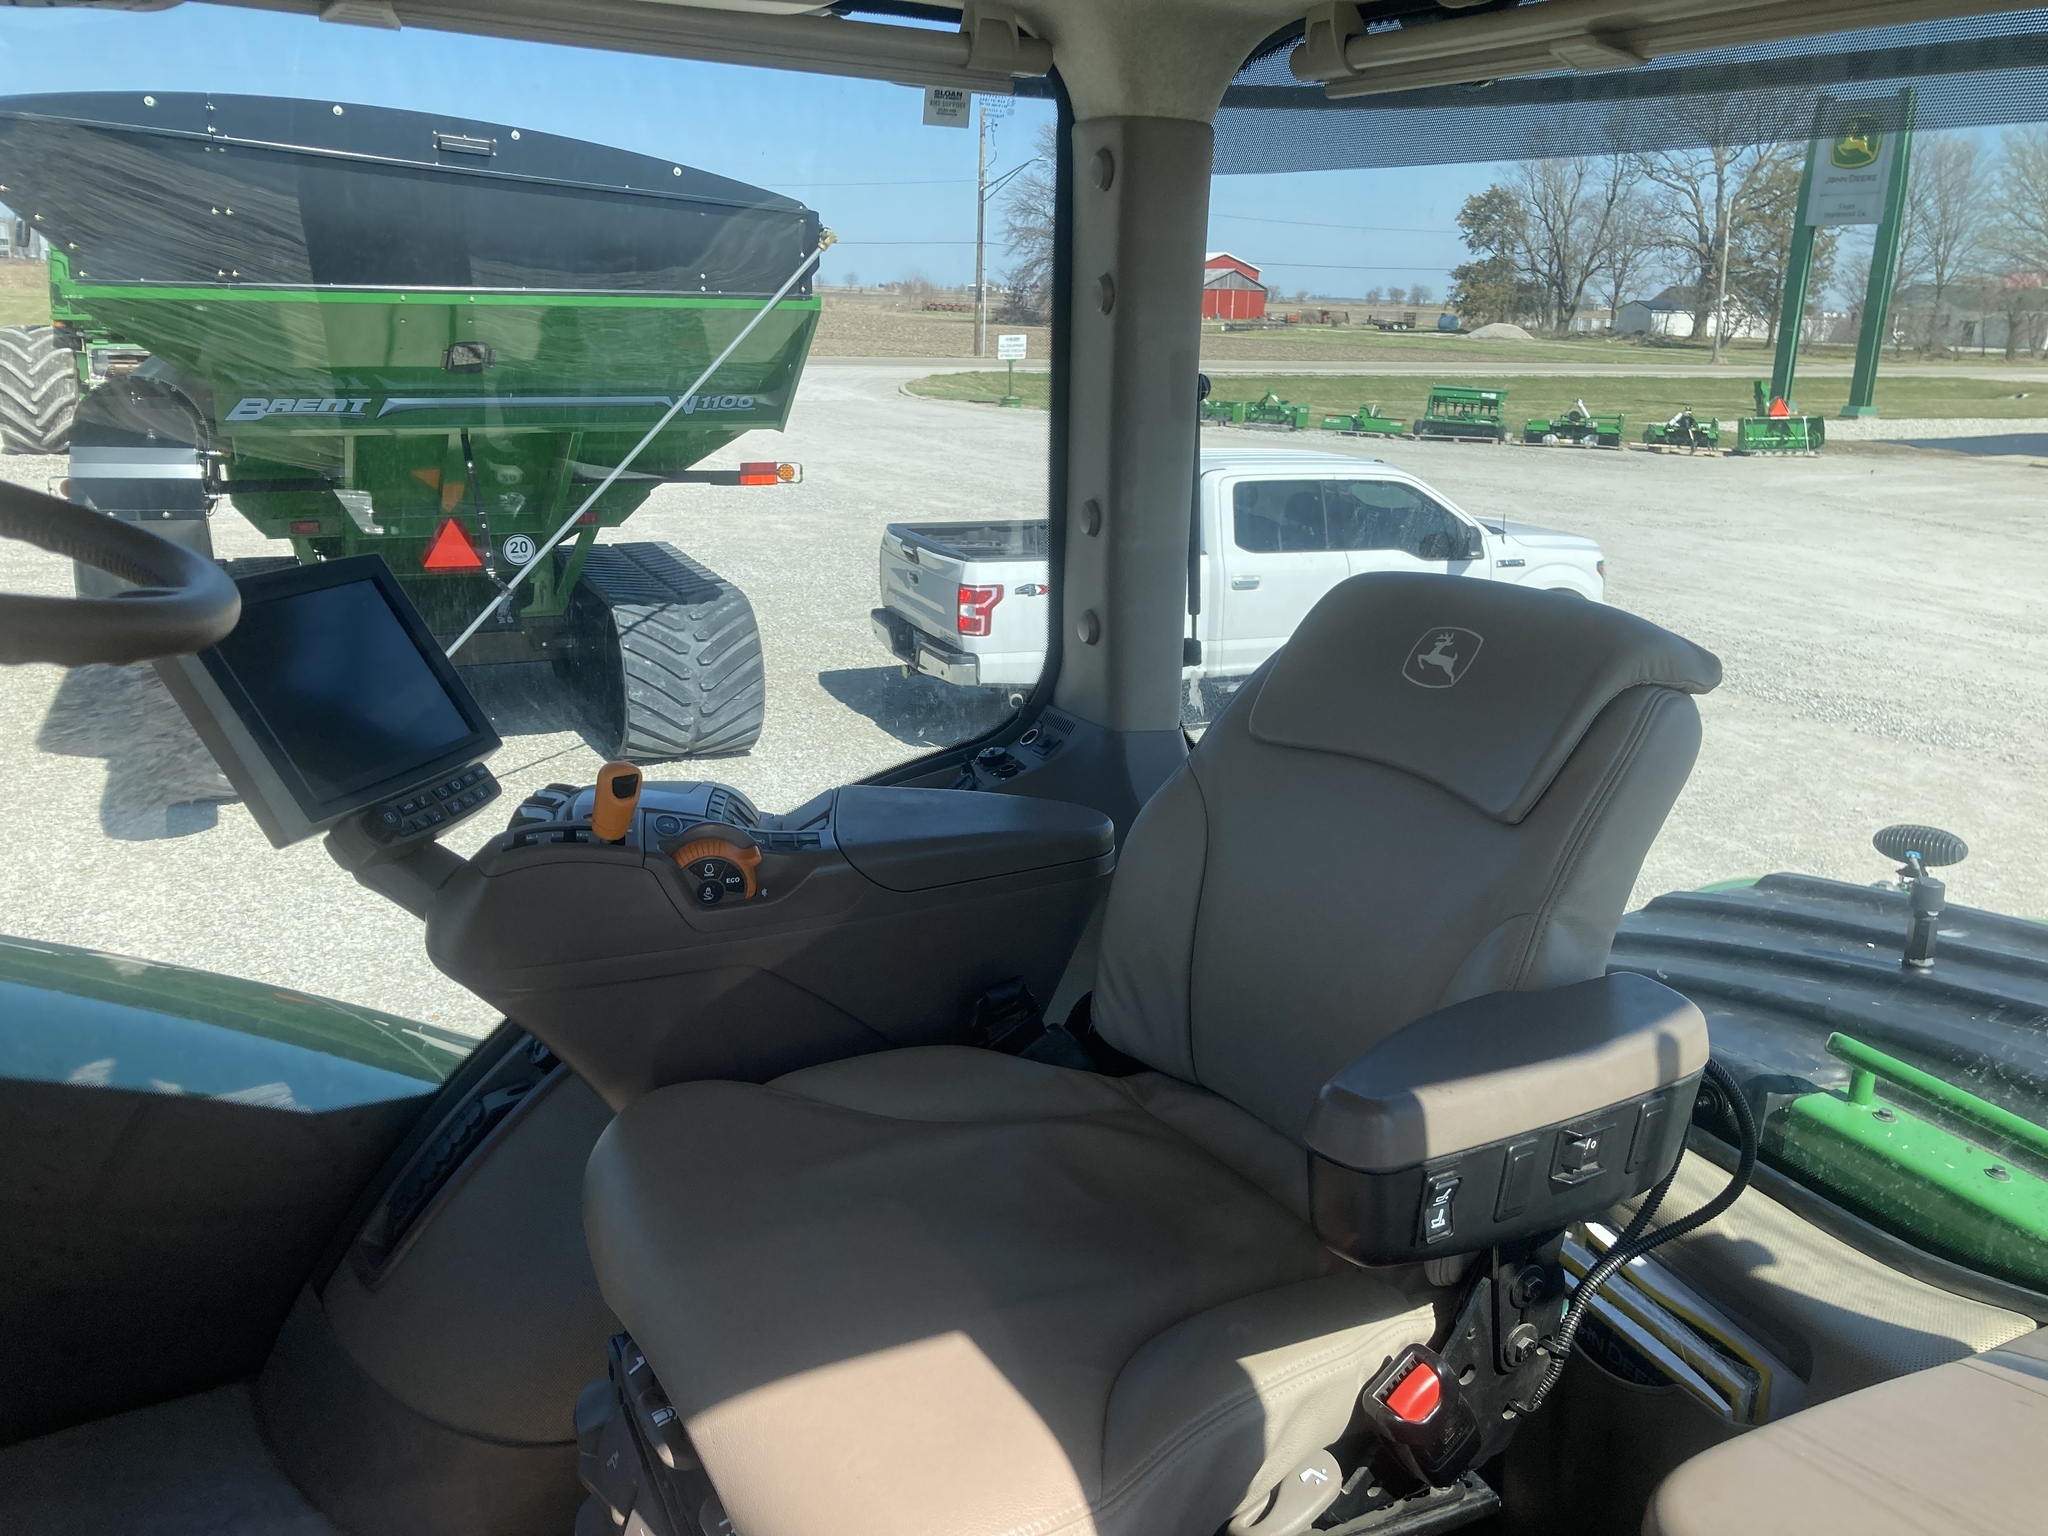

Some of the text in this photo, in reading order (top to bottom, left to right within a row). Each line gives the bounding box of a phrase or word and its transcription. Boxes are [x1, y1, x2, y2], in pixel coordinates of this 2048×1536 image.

[934, 89, 963, 97] SLOAN
[1824, 174, 1878, 184] JOHN DEERE
[225, 397, 372, 421] BRENT
[510, 541, 528, 554] 20
[726, 876, 740, 884] ECO
